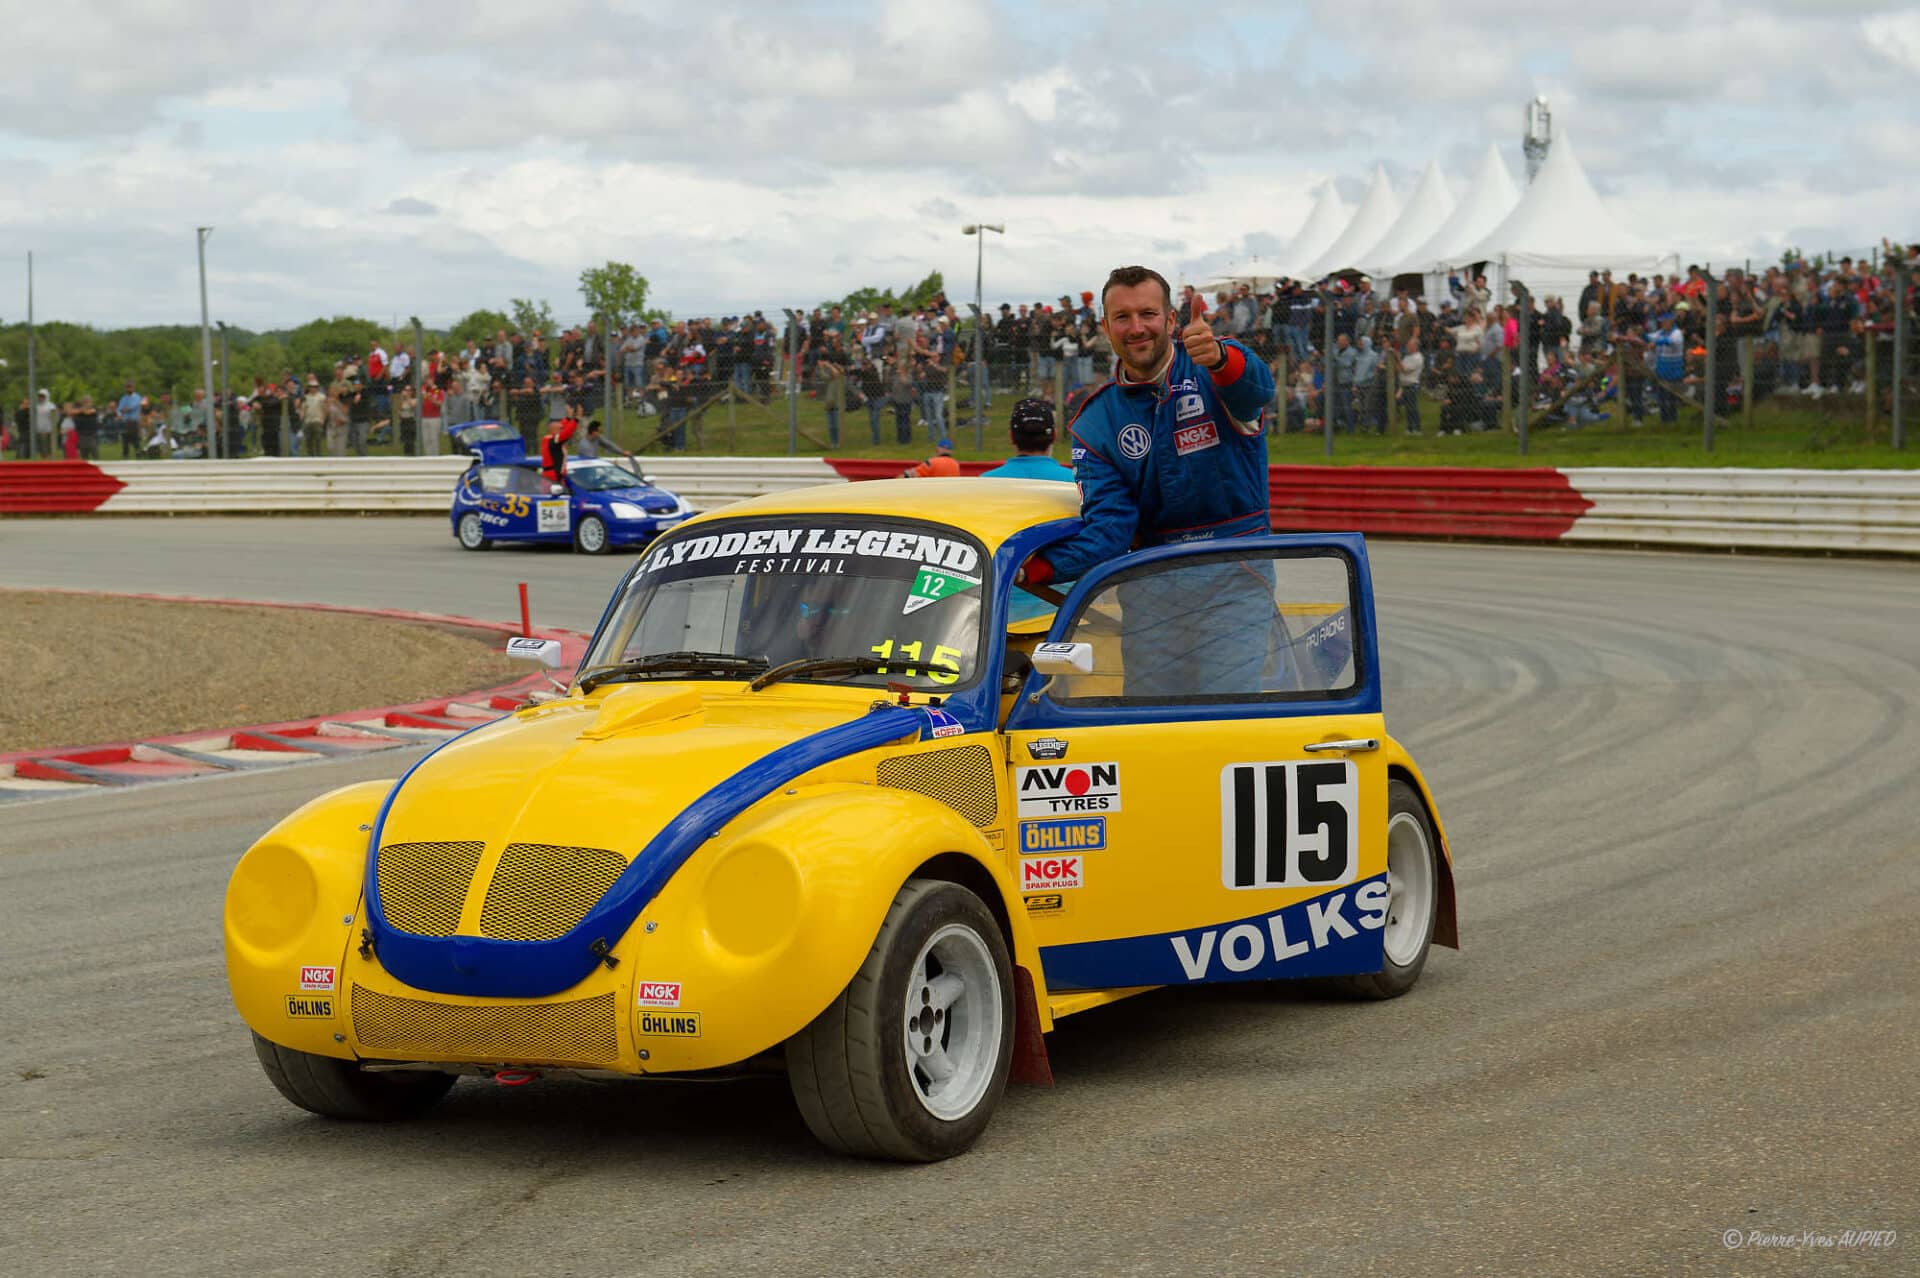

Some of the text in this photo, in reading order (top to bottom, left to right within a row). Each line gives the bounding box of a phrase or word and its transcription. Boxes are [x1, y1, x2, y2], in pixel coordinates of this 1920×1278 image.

[1177, 426, 1212, 446] NGK
[500, 493, 532, 518] 35
[647, 529, 978, 573] LYDDEN LEGEND
[735, 558, 847, 574] FESTIVAL
[922, 574, 946, 596] 12
[871, 639, 962, 685] 115
[1021, 764, 1118, 797] AVON
[1049, 797, 1110, 812] TYRES
[1233, 762, 1349, 887] 115
[1026, 823, 1101, 850] ÖHLINS
[1024, 858, 1078, 881] NGK
[1052, 880, 1078, 888] PLUGS
[1170, 881, 1388, 981] VOLKS
[304, 969, 331, 982] NGK
[643, 985, 676, 999] NGK
[289, 997, 331, 1016] ÖHLINS
[642, 1013, 696, 1033] ÖHLINS
